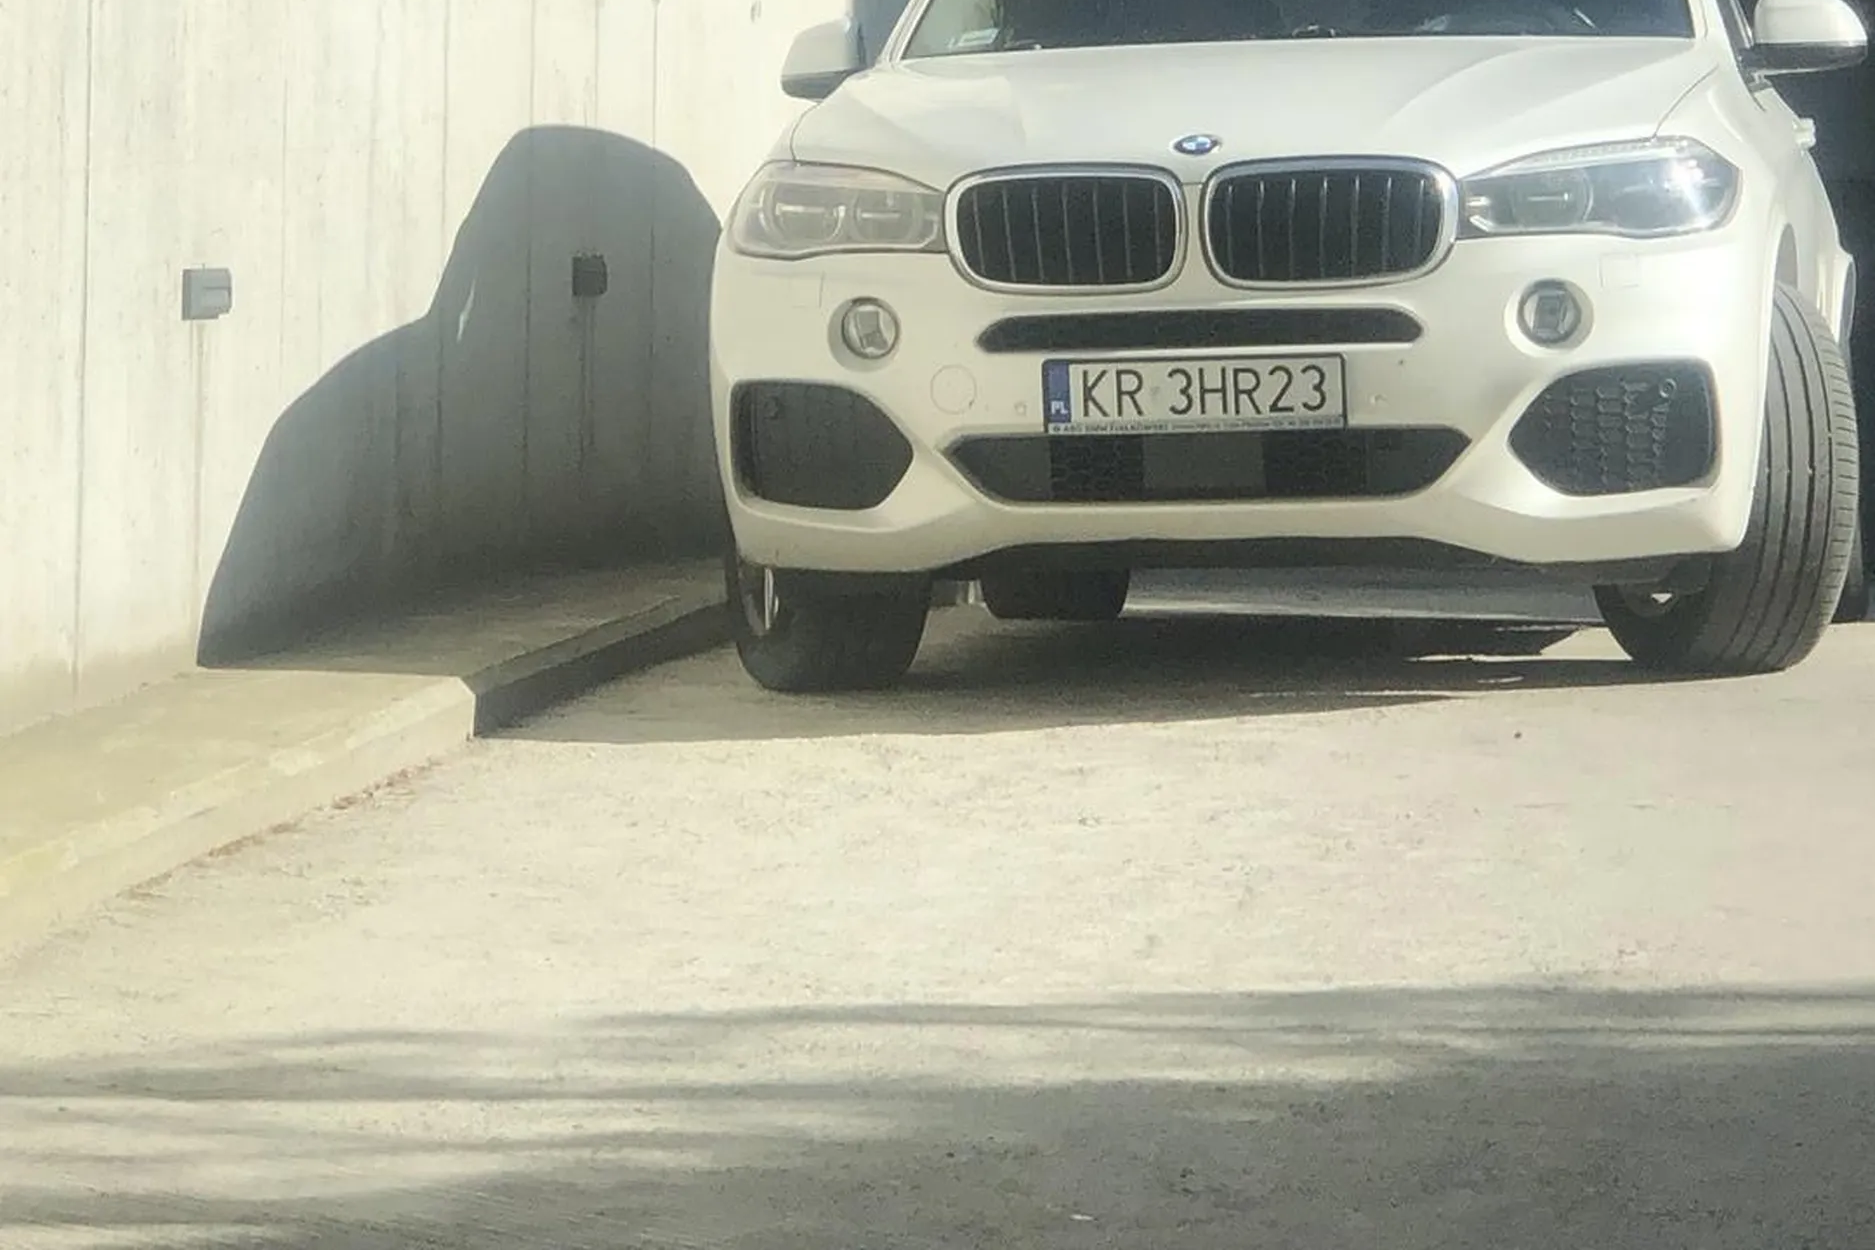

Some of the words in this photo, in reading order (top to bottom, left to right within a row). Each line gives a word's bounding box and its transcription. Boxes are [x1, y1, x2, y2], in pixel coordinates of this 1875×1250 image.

[1082, 368, 1146, 417] KR
[1166, 364, 1327, 416] 3HR23
[1050, 400, 1069, 416] PL
